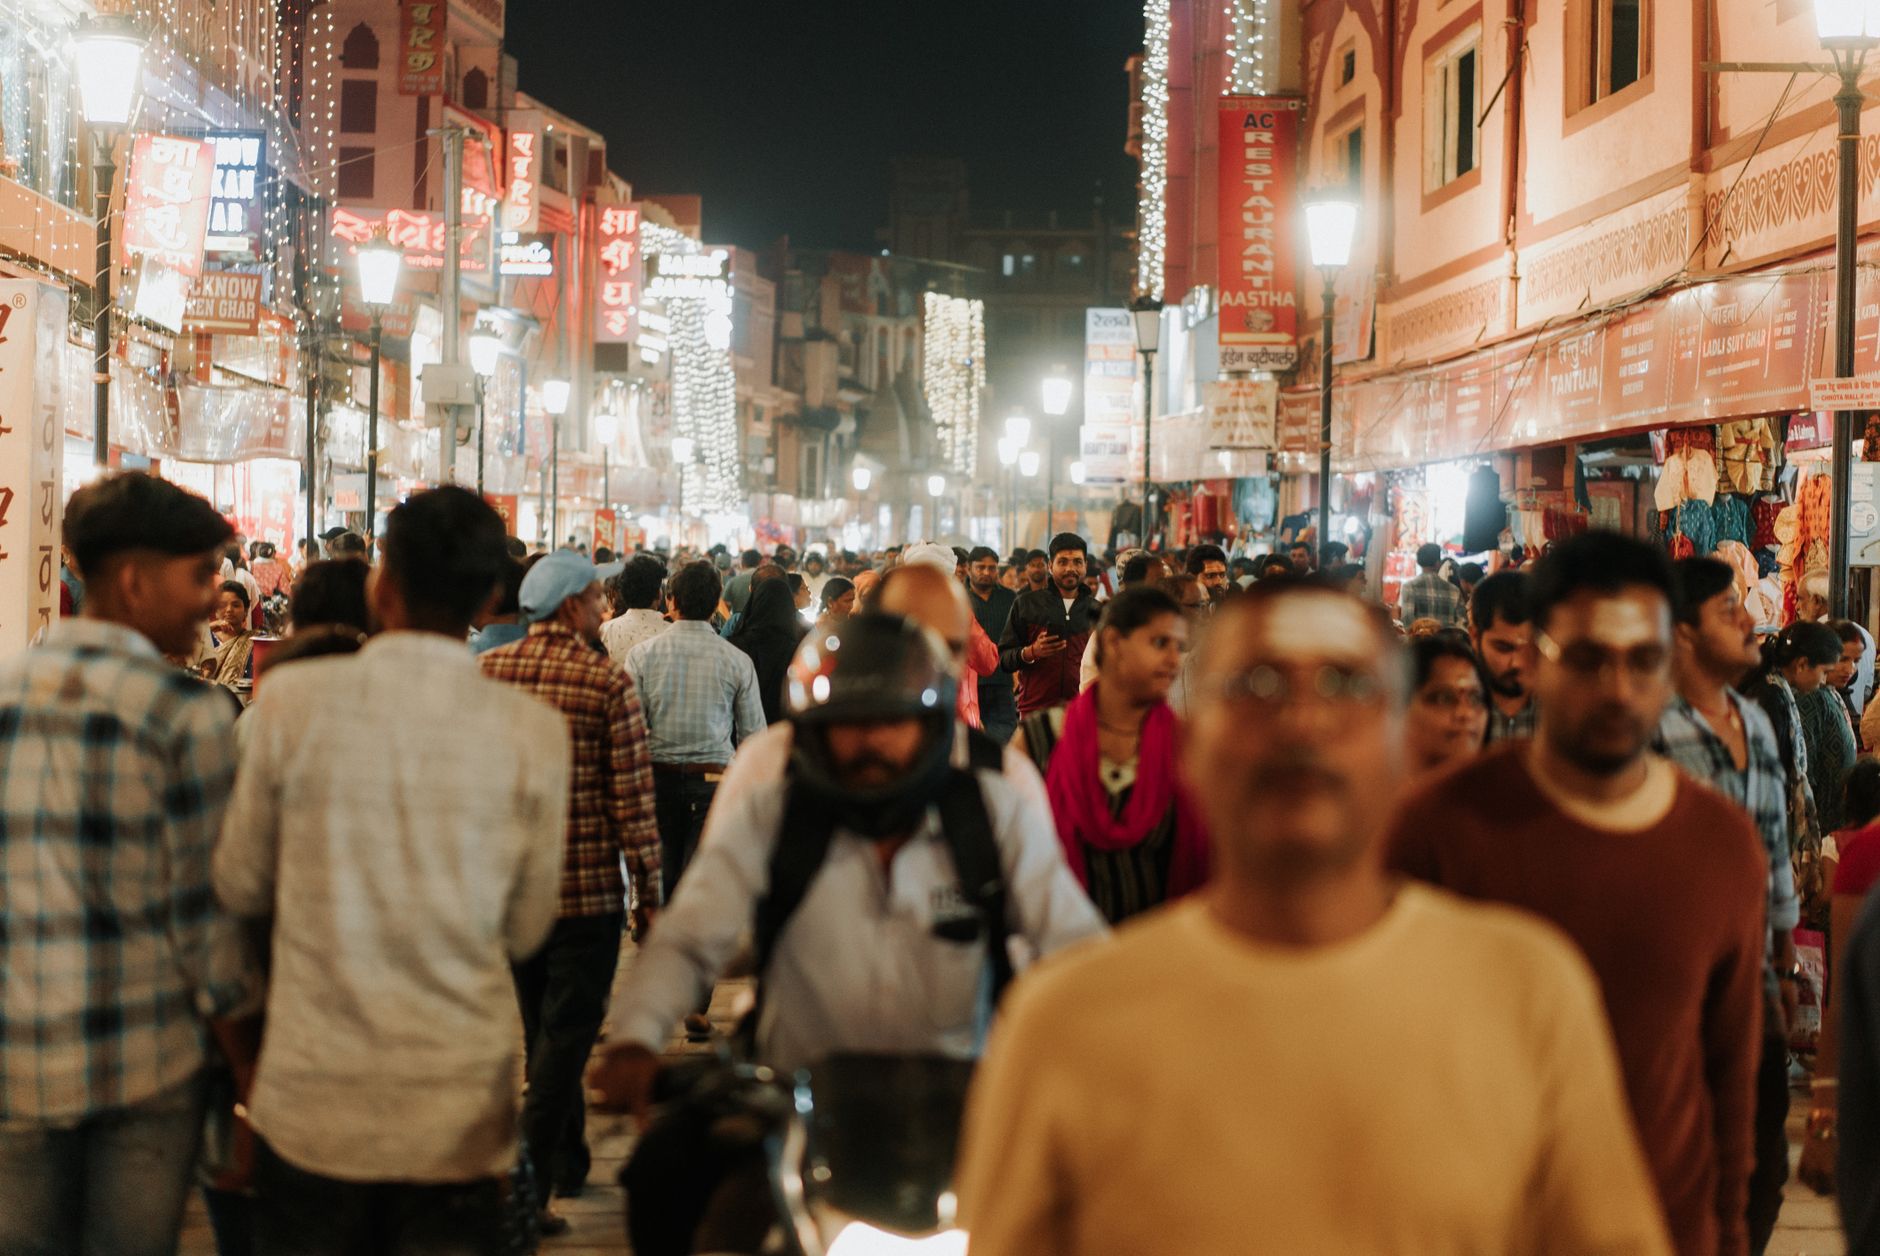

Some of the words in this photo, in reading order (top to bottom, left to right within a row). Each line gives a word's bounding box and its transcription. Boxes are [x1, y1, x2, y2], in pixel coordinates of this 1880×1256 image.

[1243, 113, 1275, 129] AC
[1242, 131, 1275, 288] RESTAURANT
[186, 275, 259, 299] CKNOW
[1220, 290, 1296, 308] AASTHA
[219, 300, 257, 320] GHAR
[1702, 337, 1726, 359] LADLI
[1726, 333, 1745, 355] SUIT
[1745, 327, 1767, 350] GHAR
[1550, 366, 1599, 397] TANTUJA
